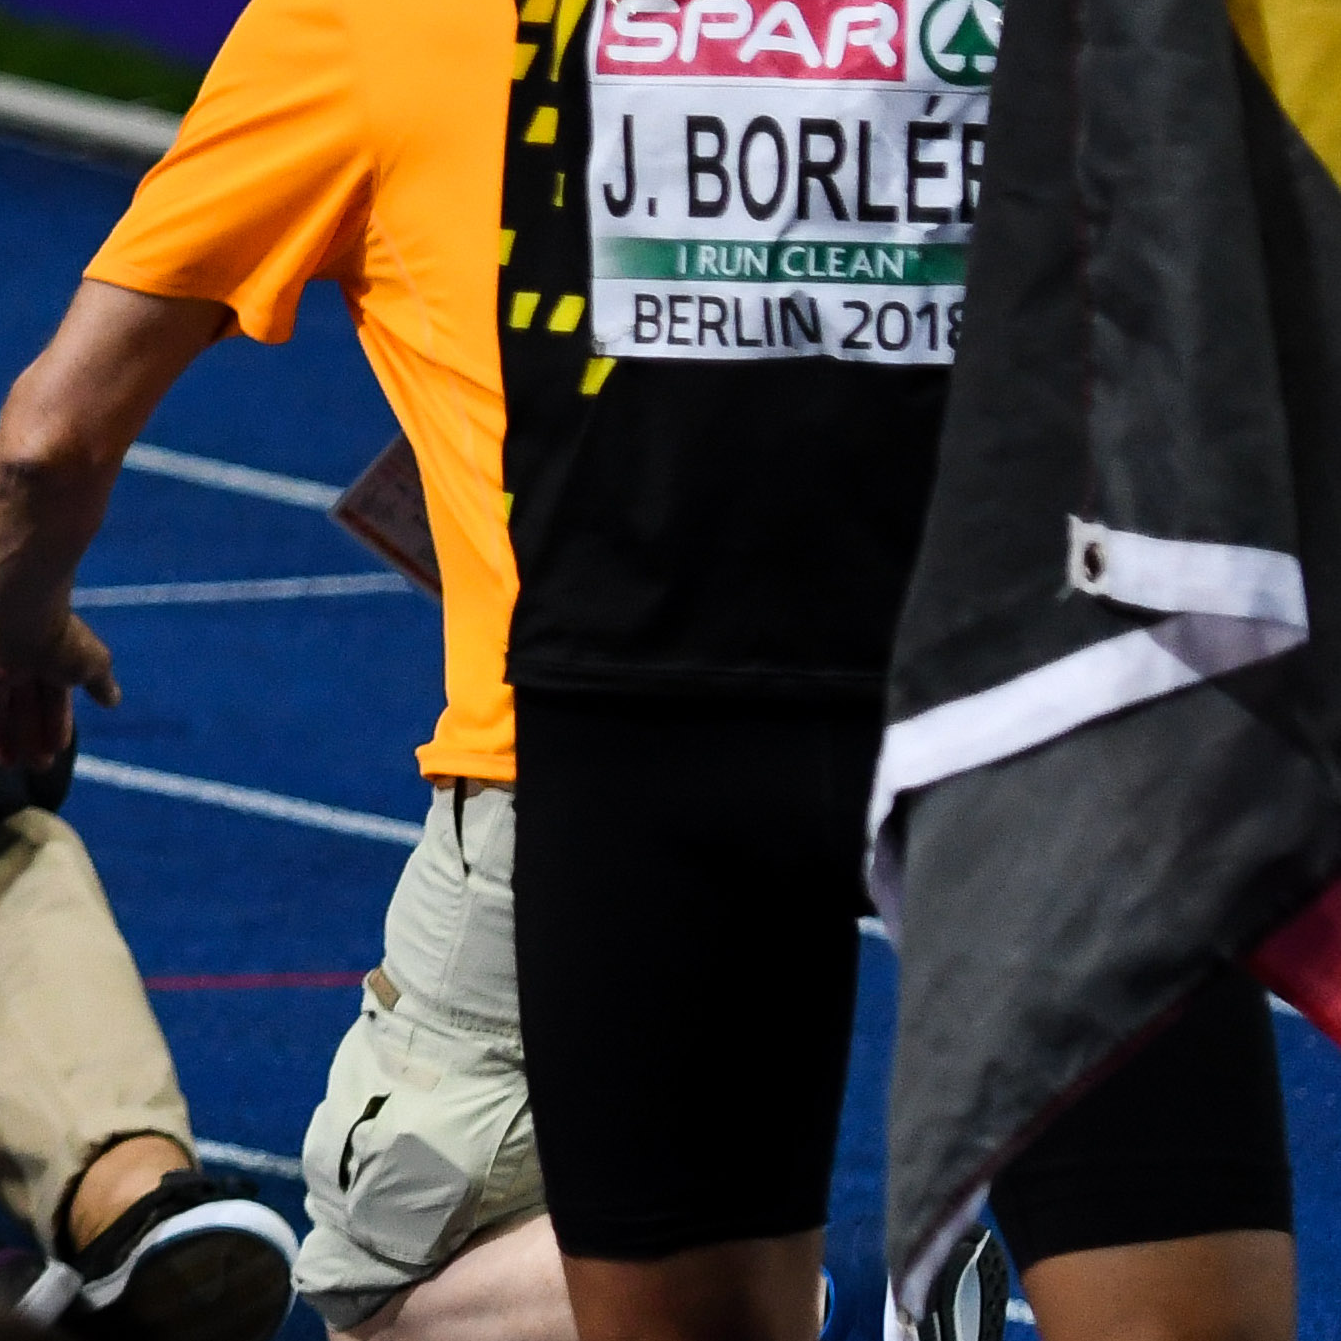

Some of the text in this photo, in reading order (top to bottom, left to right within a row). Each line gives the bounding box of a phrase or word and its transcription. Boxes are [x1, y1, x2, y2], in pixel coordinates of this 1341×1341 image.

[603, 114, 659, 219] J.
[677, 245, 687, 275] I
[696, 246, 769, 278] RUN
[634, 293, 823, 346] BERLIN
